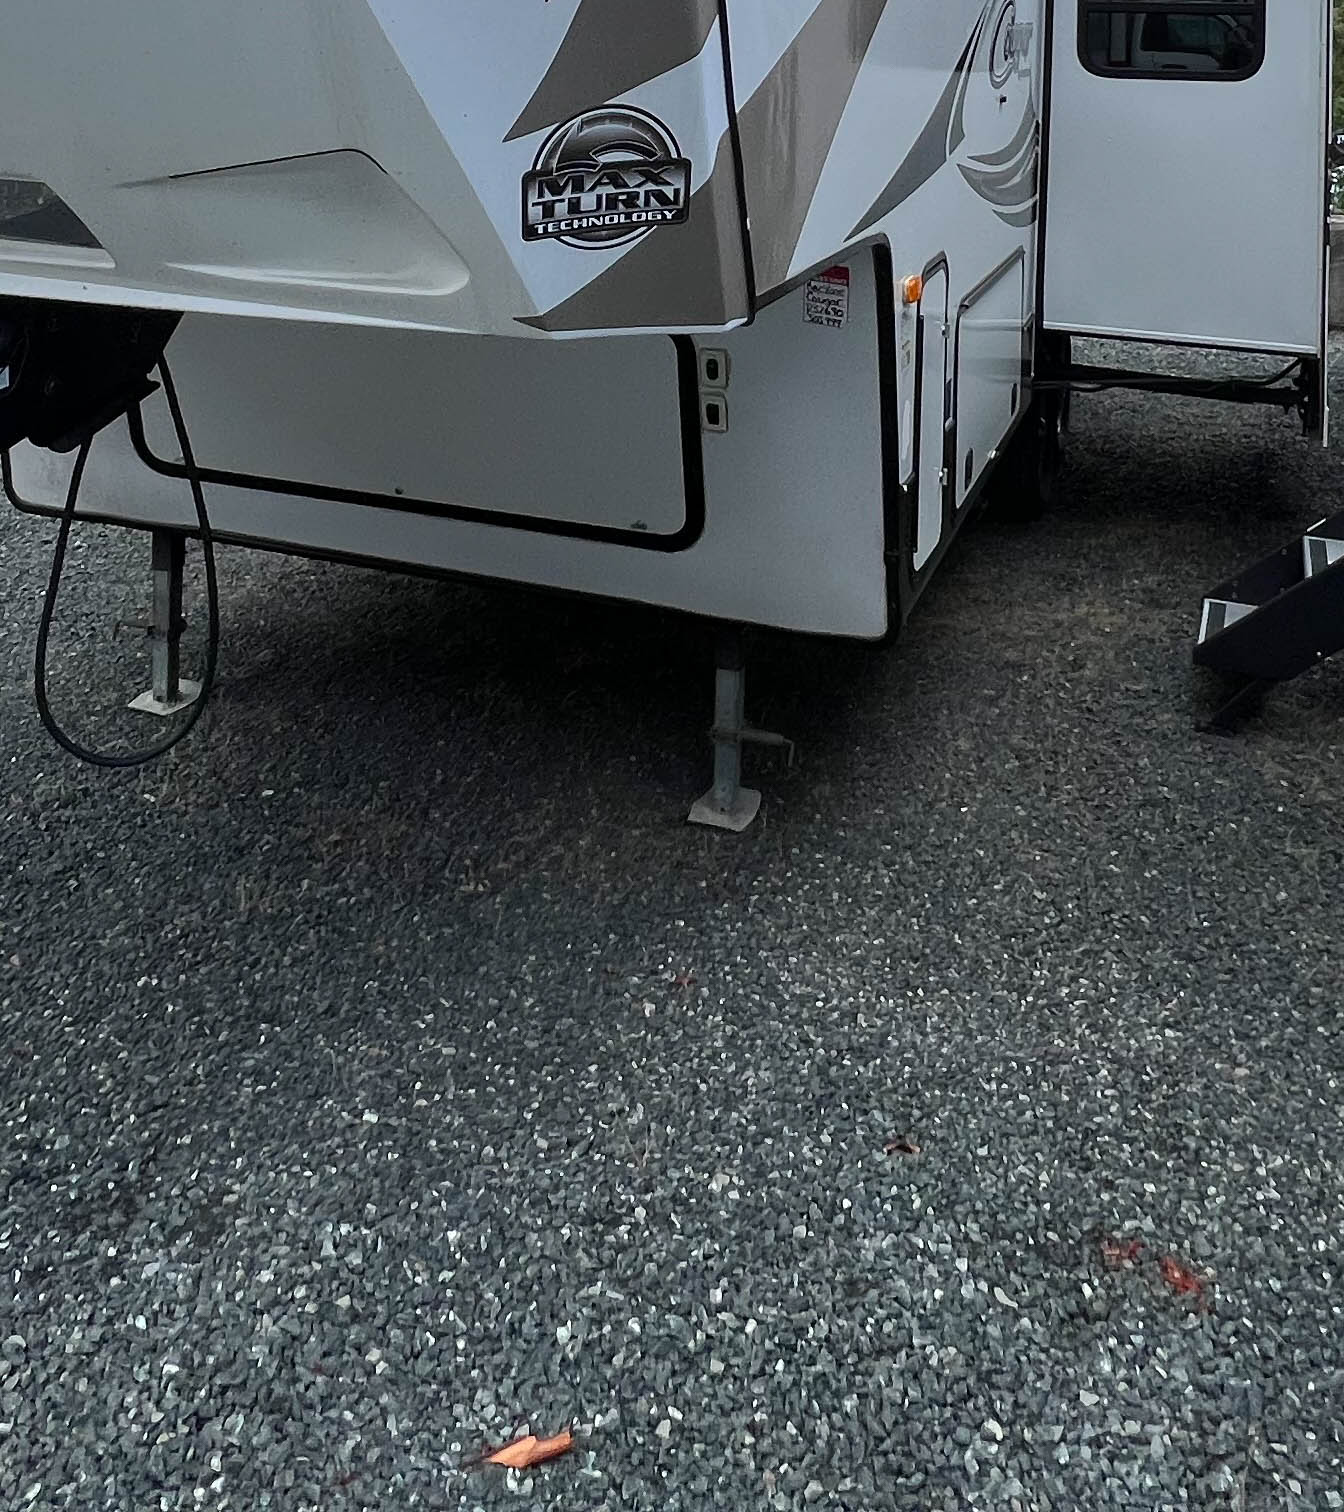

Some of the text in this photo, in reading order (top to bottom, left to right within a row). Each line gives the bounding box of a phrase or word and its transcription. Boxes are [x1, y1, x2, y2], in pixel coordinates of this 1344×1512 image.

[537, 166, 675, 199] MAX
[532, 188, 681, 220] TURN
[534, 209, 678, 235] TECHNOLOGY
